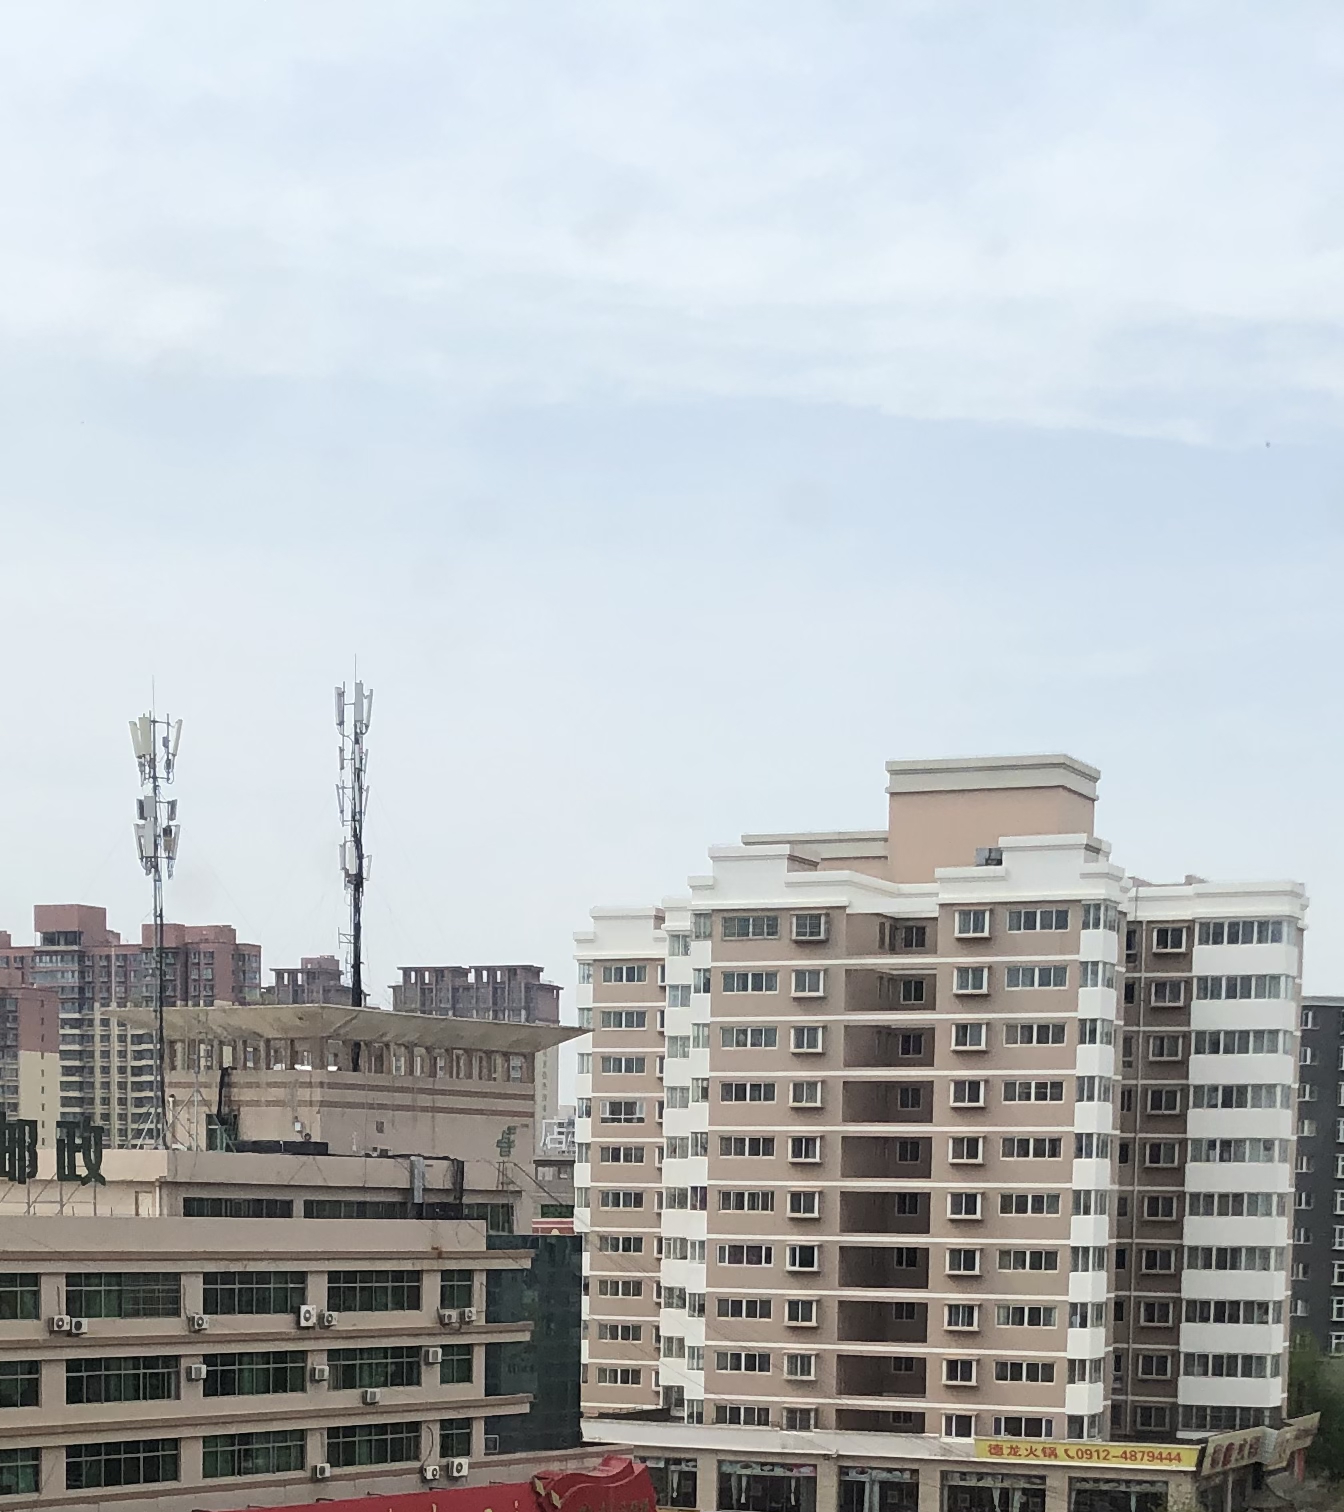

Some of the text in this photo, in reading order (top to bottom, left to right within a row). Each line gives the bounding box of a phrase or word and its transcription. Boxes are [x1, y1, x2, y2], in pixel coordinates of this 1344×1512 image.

[987, 1443, 1183, 1464] 德龙火锅 0912-4879444
